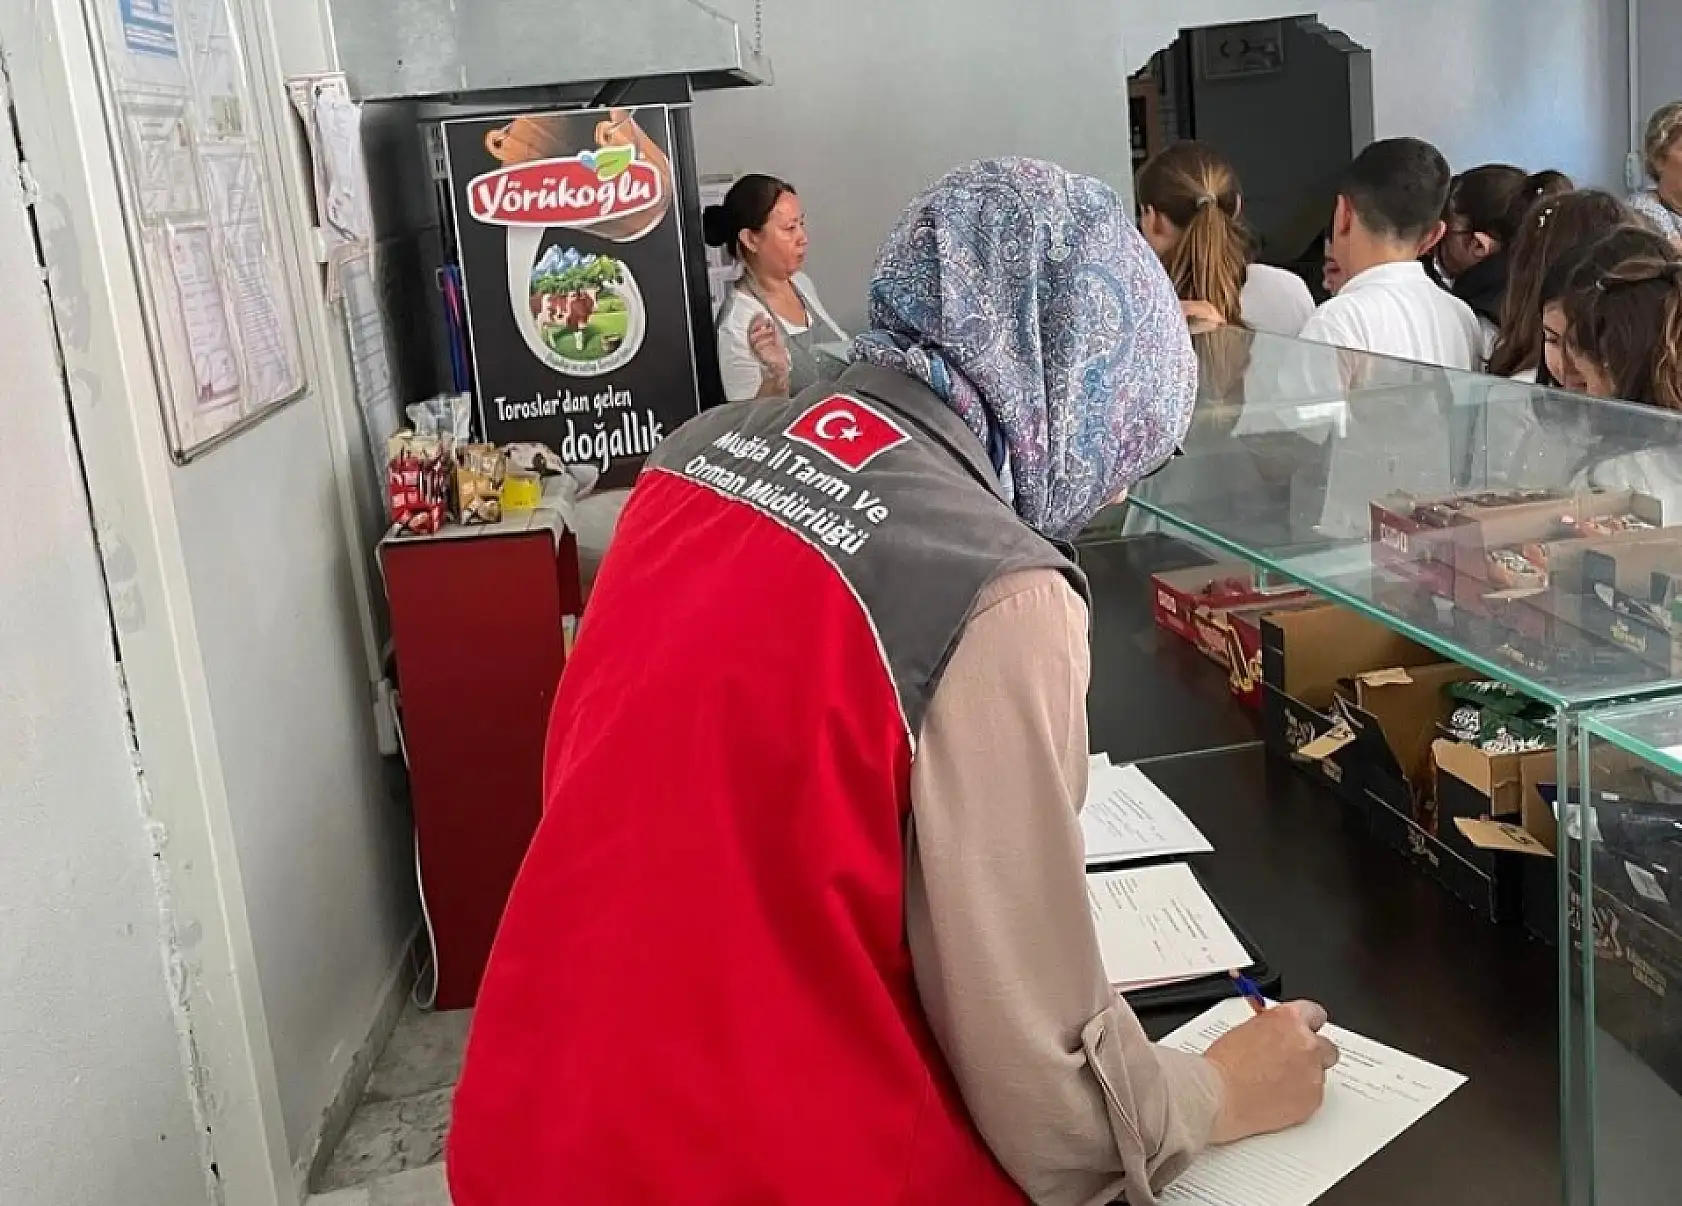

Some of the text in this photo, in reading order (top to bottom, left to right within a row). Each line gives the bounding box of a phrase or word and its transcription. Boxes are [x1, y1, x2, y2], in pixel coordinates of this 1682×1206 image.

[494, 385, 632, 421] Toroslar'dan gelen
[561, 409, 664, 474] doğallık
[684, 454, 871, 555] Orman Müdürlüğü
[712, 430, 771, 462] Muğla
[851, 489, 889, 525] Ve
